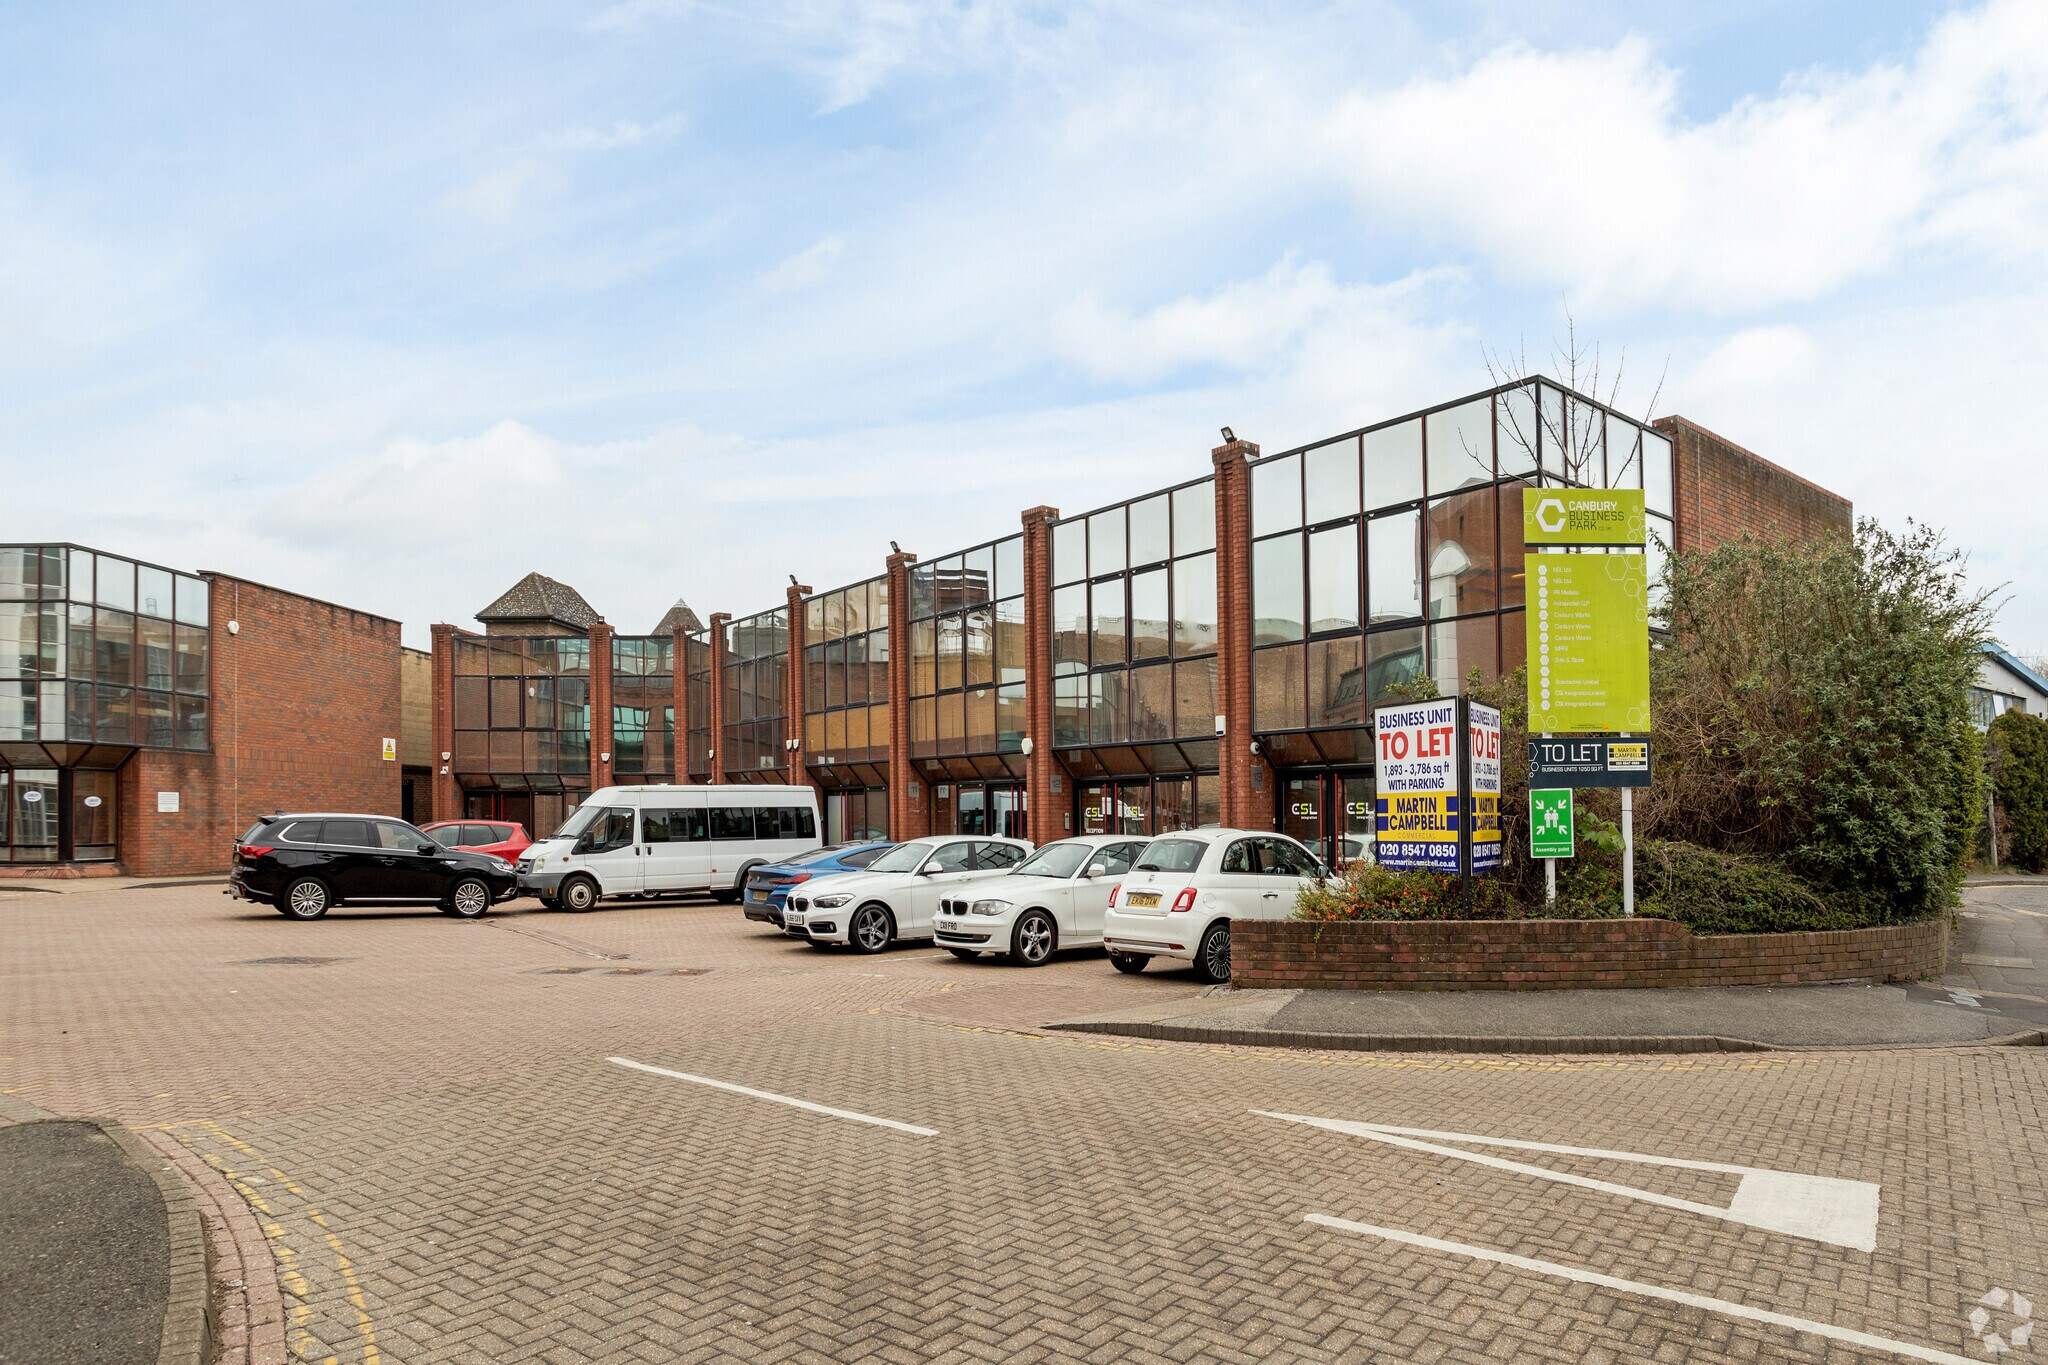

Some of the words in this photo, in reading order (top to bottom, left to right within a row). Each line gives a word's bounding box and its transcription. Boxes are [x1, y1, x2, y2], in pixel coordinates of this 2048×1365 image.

[1569, 501, 1617, 510] CANBURY
[1570, 511, 1624, 521] BUSINESS
[1570, 521, 1596, 530] PARK
[1380, 711, 1424, 729] BUSINESS
[1428, 708, 1452, 724] UNIT
[1470, 709, 1489, 726] BUSINESS
[1380, 731, 1409, 760] TO
[1417, 727, 1453, 758] LET
[1470, 728, 1484, 758] TO
[1487, 730, 1499, 759] LET
[1541, 744, 1565, 762] TO
[1571, 744, 1602, 761] LET
[1384, 765, 1402, 777] 1,893
[1410, 763, 1431, 776] 3,786
[1433, 765, 1442, 776] sq
[1444, 761, 1449, 772] ft
[1388, 780, 1406, 790] WITH
[1409, 778, 1444, 790] PARKING
[1086, 807, 1103, 817] CSL
[1292, 803, 1317, 815] CSL
[1346, 802, 1375, 814] CSL
[1397, 797, 1436, 813] MARTIN
[1479, 797, 1494, 813] MARTIN
[1389, 814, 1445, 830] CAMPBELL
[1478, 815, 1498, 830] CAMPBELL
[1380, 844, 1399, 856] 020
[1402, 844, 1426, 856] 8547
[1429, 845, 1456, 857] 0850
